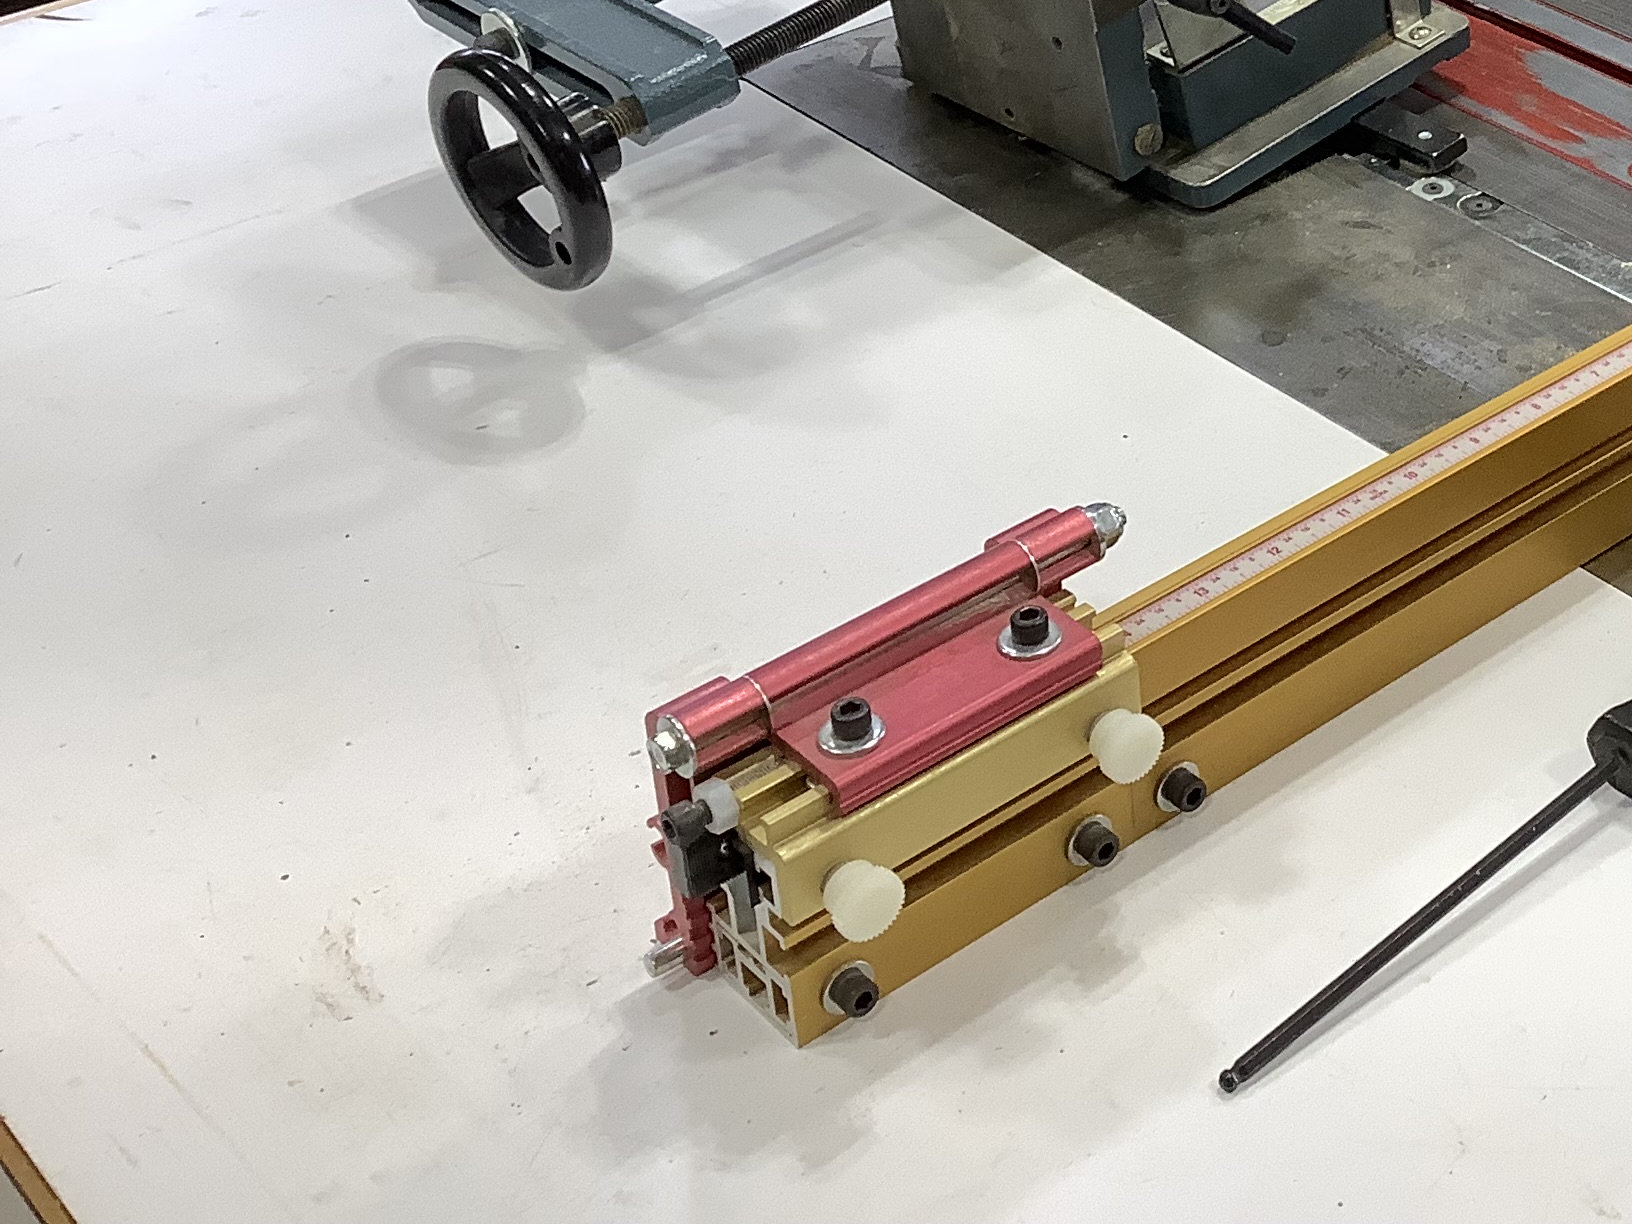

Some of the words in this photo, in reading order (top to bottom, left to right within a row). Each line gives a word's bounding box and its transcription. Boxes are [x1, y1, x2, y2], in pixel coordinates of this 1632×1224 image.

[1193, 586, 1210, 597] 13
[1266, 546, 1283, 557] 12
[1336, 508, 1351, 518] 11
